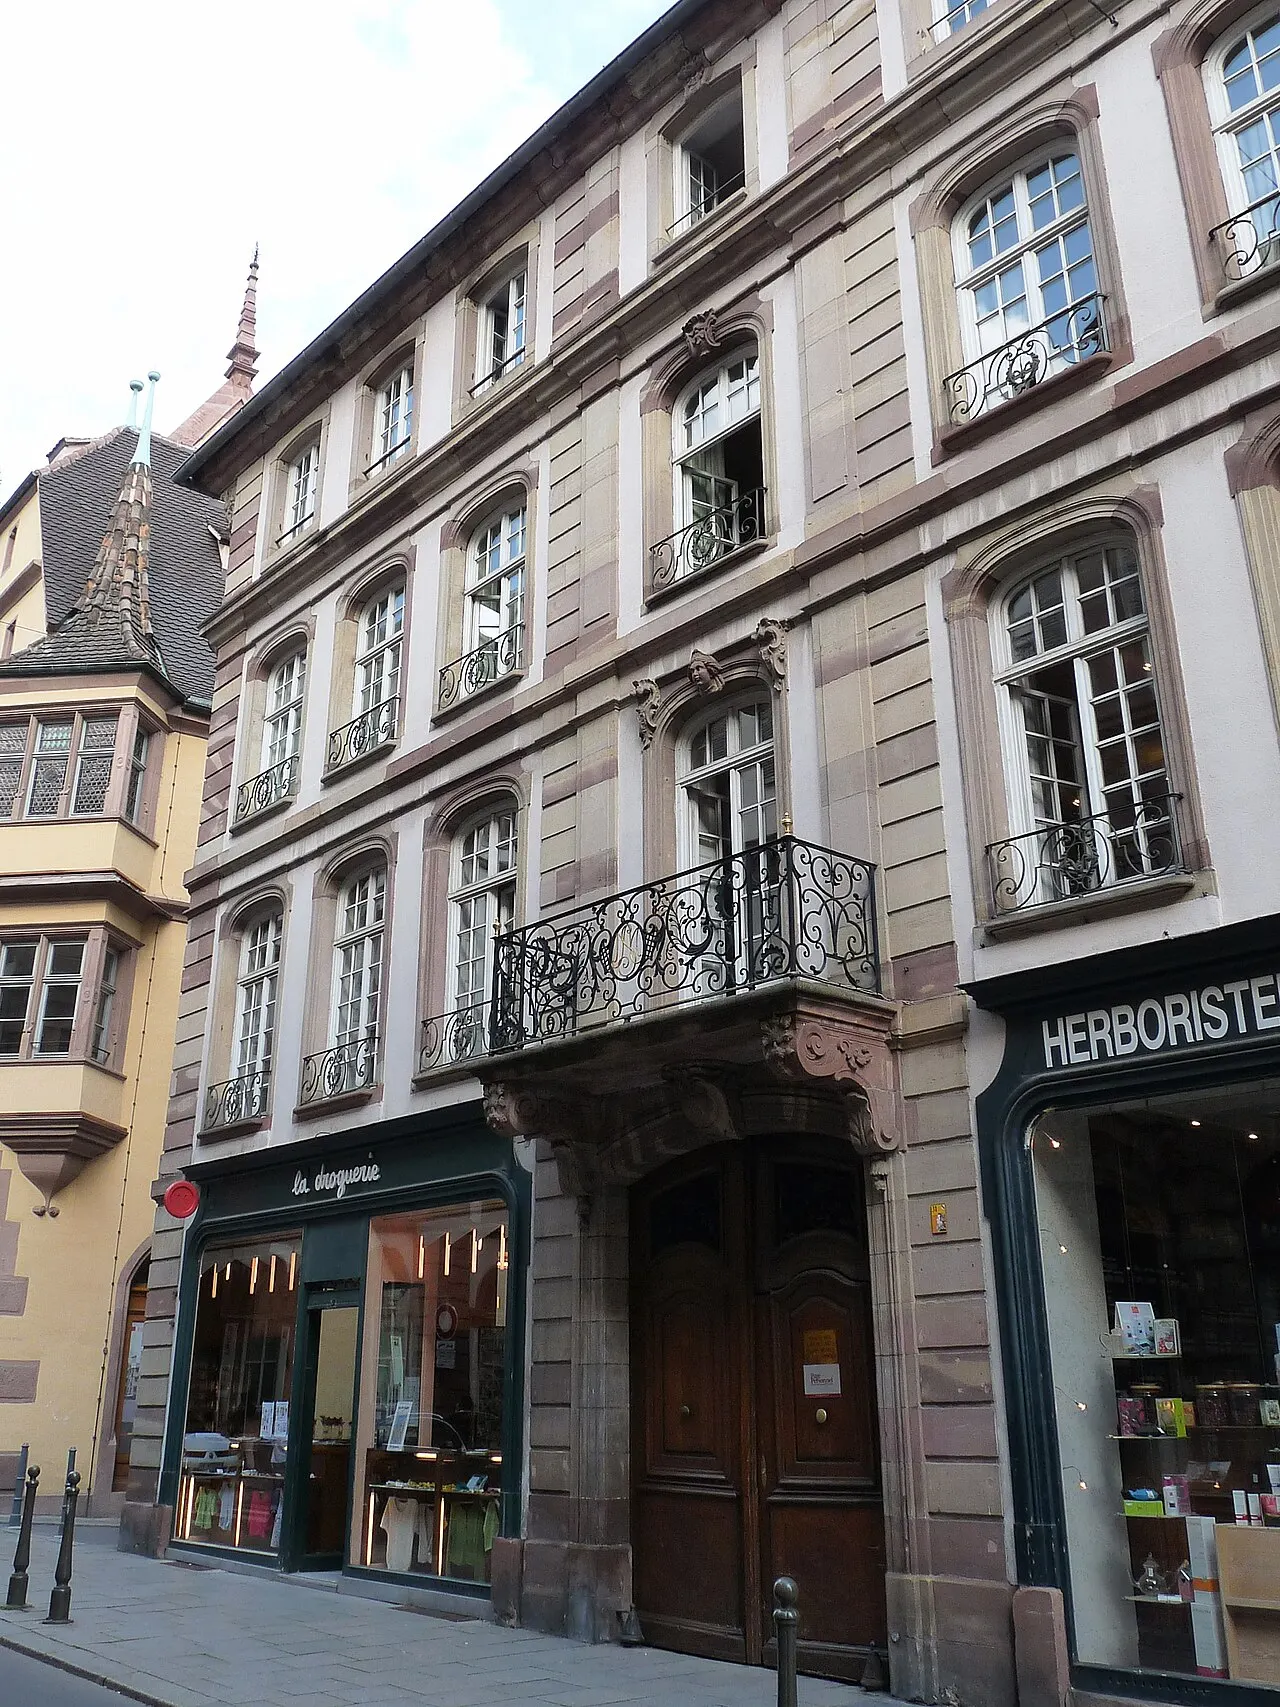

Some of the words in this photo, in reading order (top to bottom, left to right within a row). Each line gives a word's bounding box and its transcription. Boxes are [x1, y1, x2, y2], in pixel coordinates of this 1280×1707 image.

[1042, 974, 1280, 1068] HERBORISTE
[292, 1171, 311, 1196] la
[314, 1163, 381, 1199] droguerie
